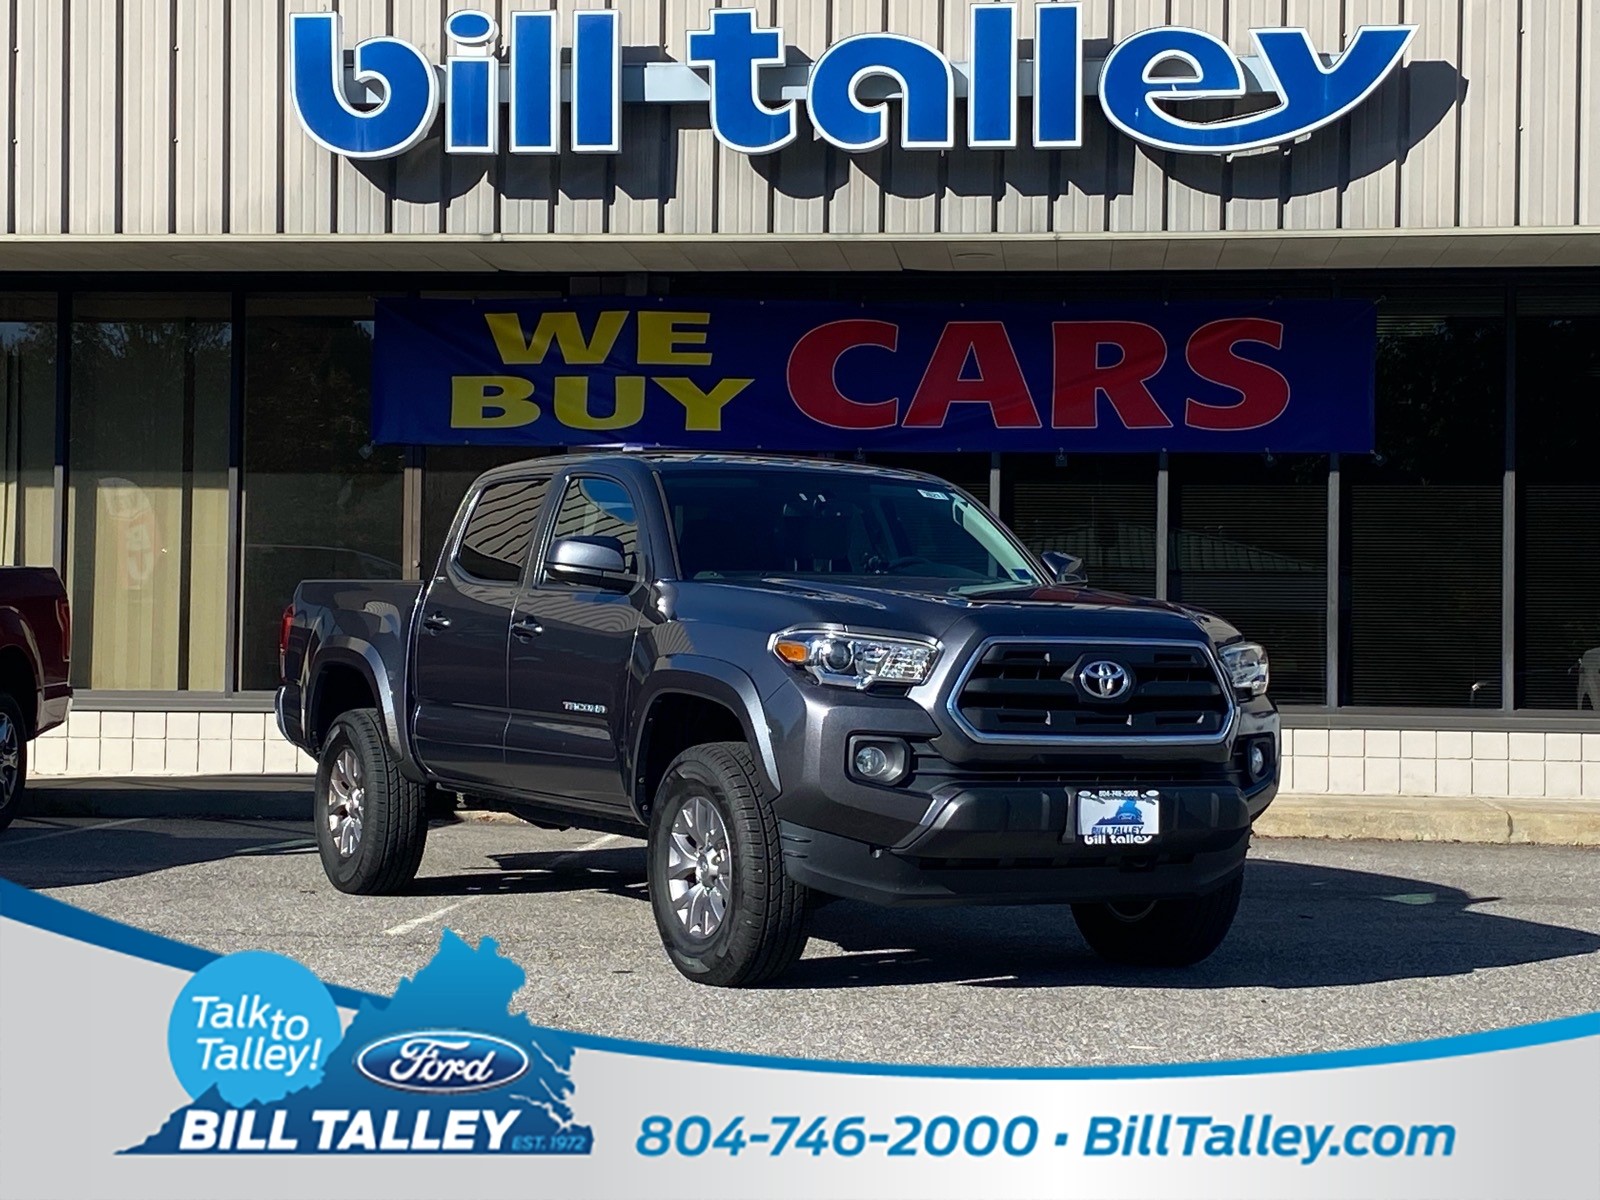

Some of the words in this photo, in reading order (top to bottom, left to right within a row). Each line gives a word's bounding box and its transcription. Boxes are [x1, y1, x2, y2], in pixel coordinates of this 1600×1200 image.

[287, 9, 622, 160] bill
[686, 1, 1419, 155] talley
[484, 311, 713, 366] WE
[786, 318, 1292, 431] CARS
[450, 376, 755, 431] BUY
[1091, 826, 1109, 836] BILL
[1111, 826, 1144, 836] TALLEY
[1110, 834, 1153, 845] talley
